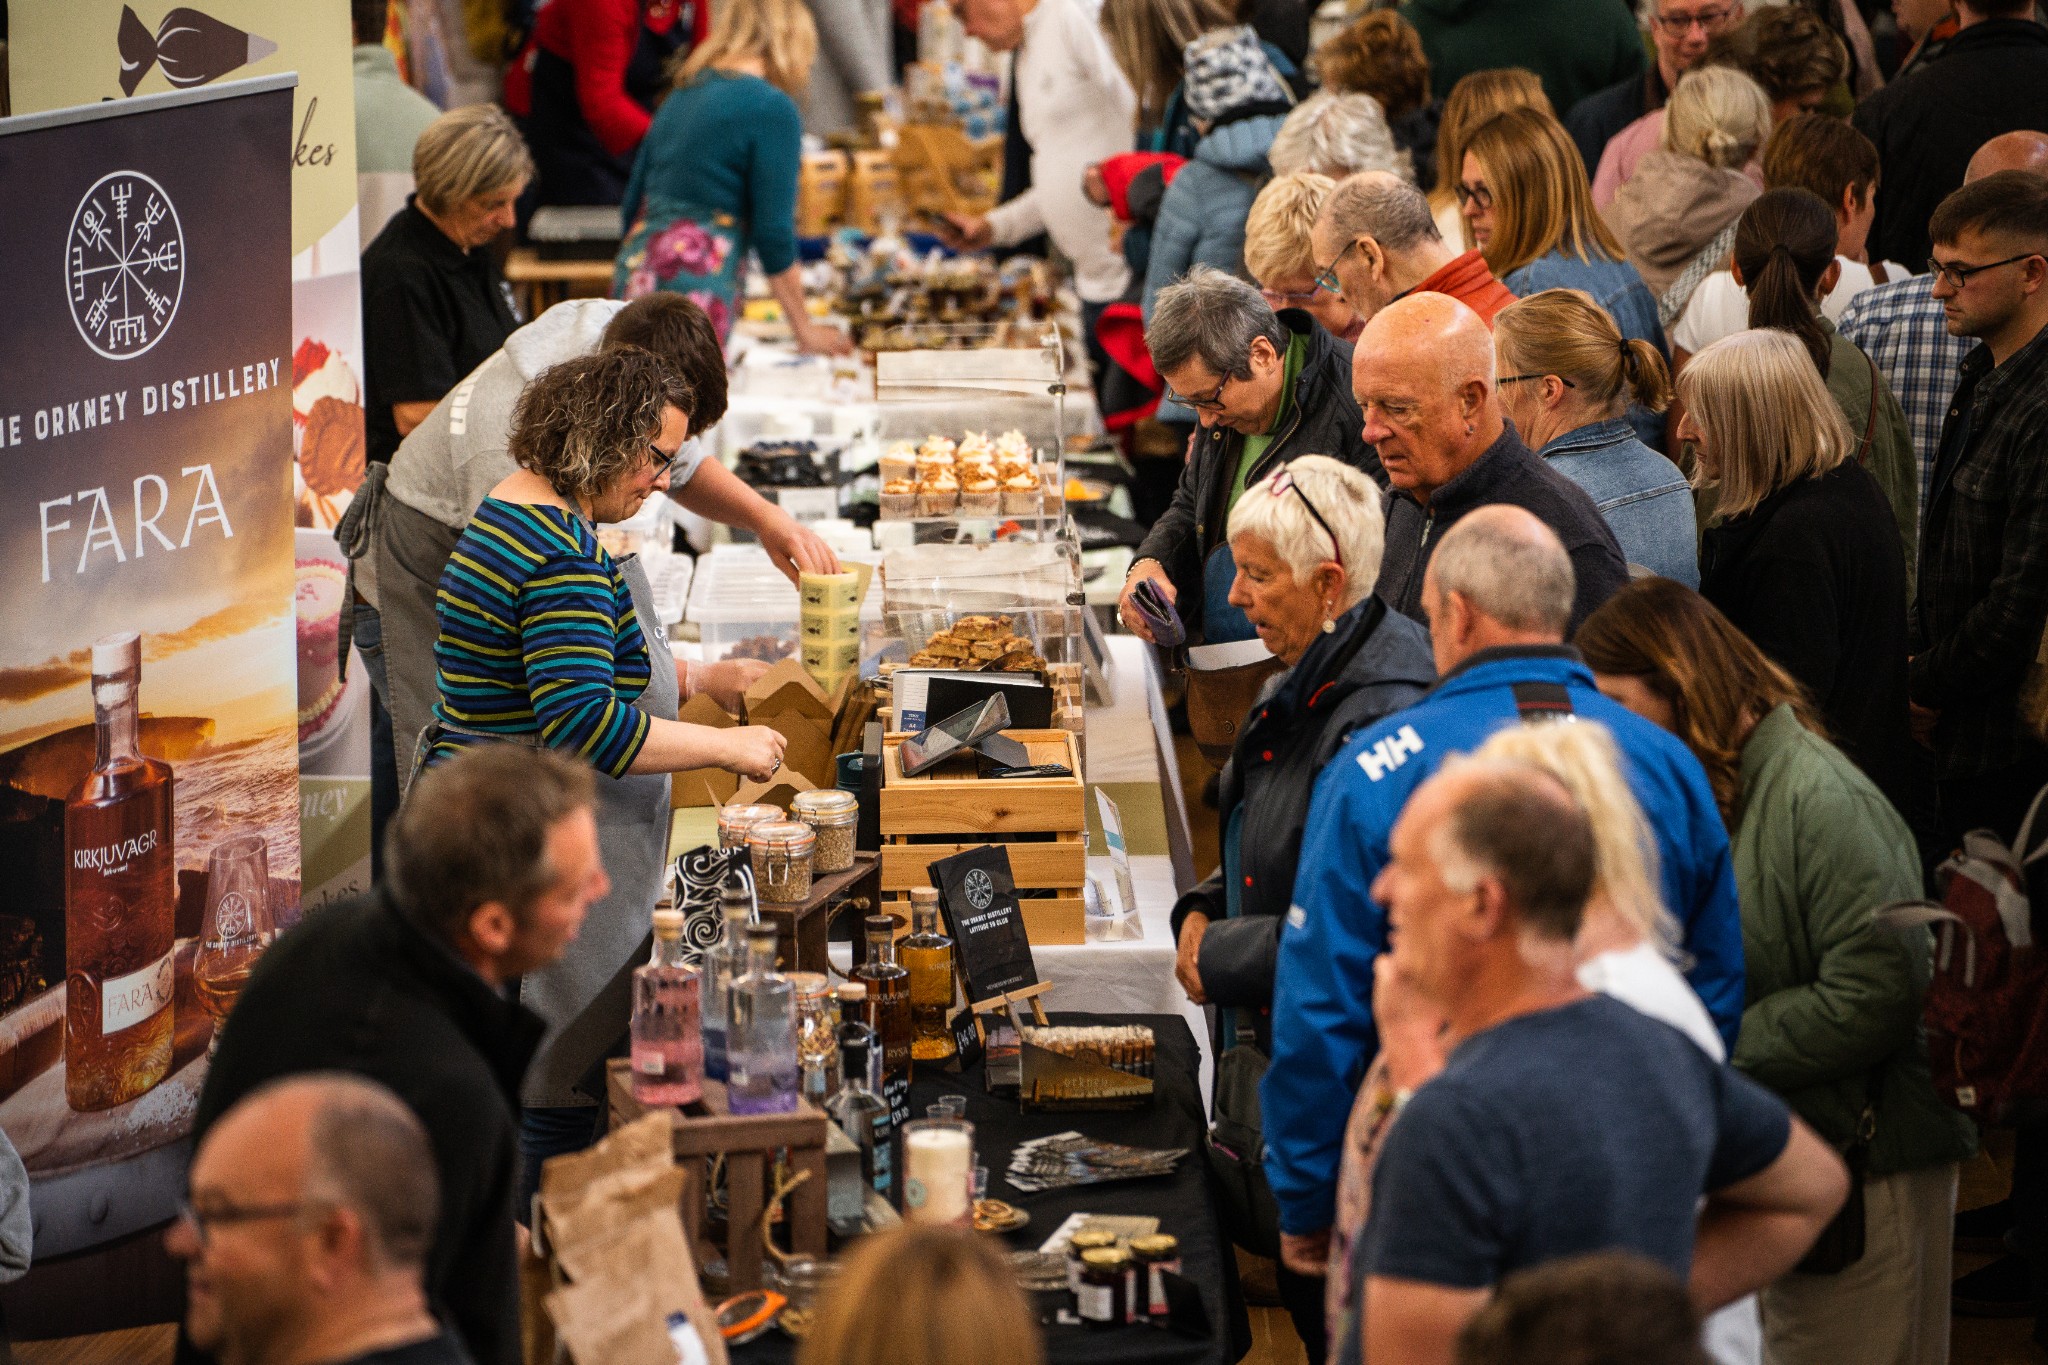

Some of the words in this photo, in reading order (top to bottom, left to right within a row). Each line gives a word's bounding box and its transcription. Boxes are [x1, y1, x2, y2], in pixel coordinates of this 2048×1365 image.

[292, 96, 336, 170] kes
[33, 390, 128, 441] ORKNEY
[141, 357, 280, 417] DISTILLERY
[38, 462, 235, 585] FARA
[1355, 723, 1426, 783] HH
[74, 828, 159, 873] KIRKJUVAGR
[960, 918, 971, 928] THE
[969, 913, 988, 925] ORKNEY
[987, 905, 1013, 920] DISTILLERY
[968, 922, 990, 935] LATITUDE
[996, 916, 1009, 927] CLUB
[107, 981, 154, 1019] FARA
[887, 1045, 909, 1058] RYSA
